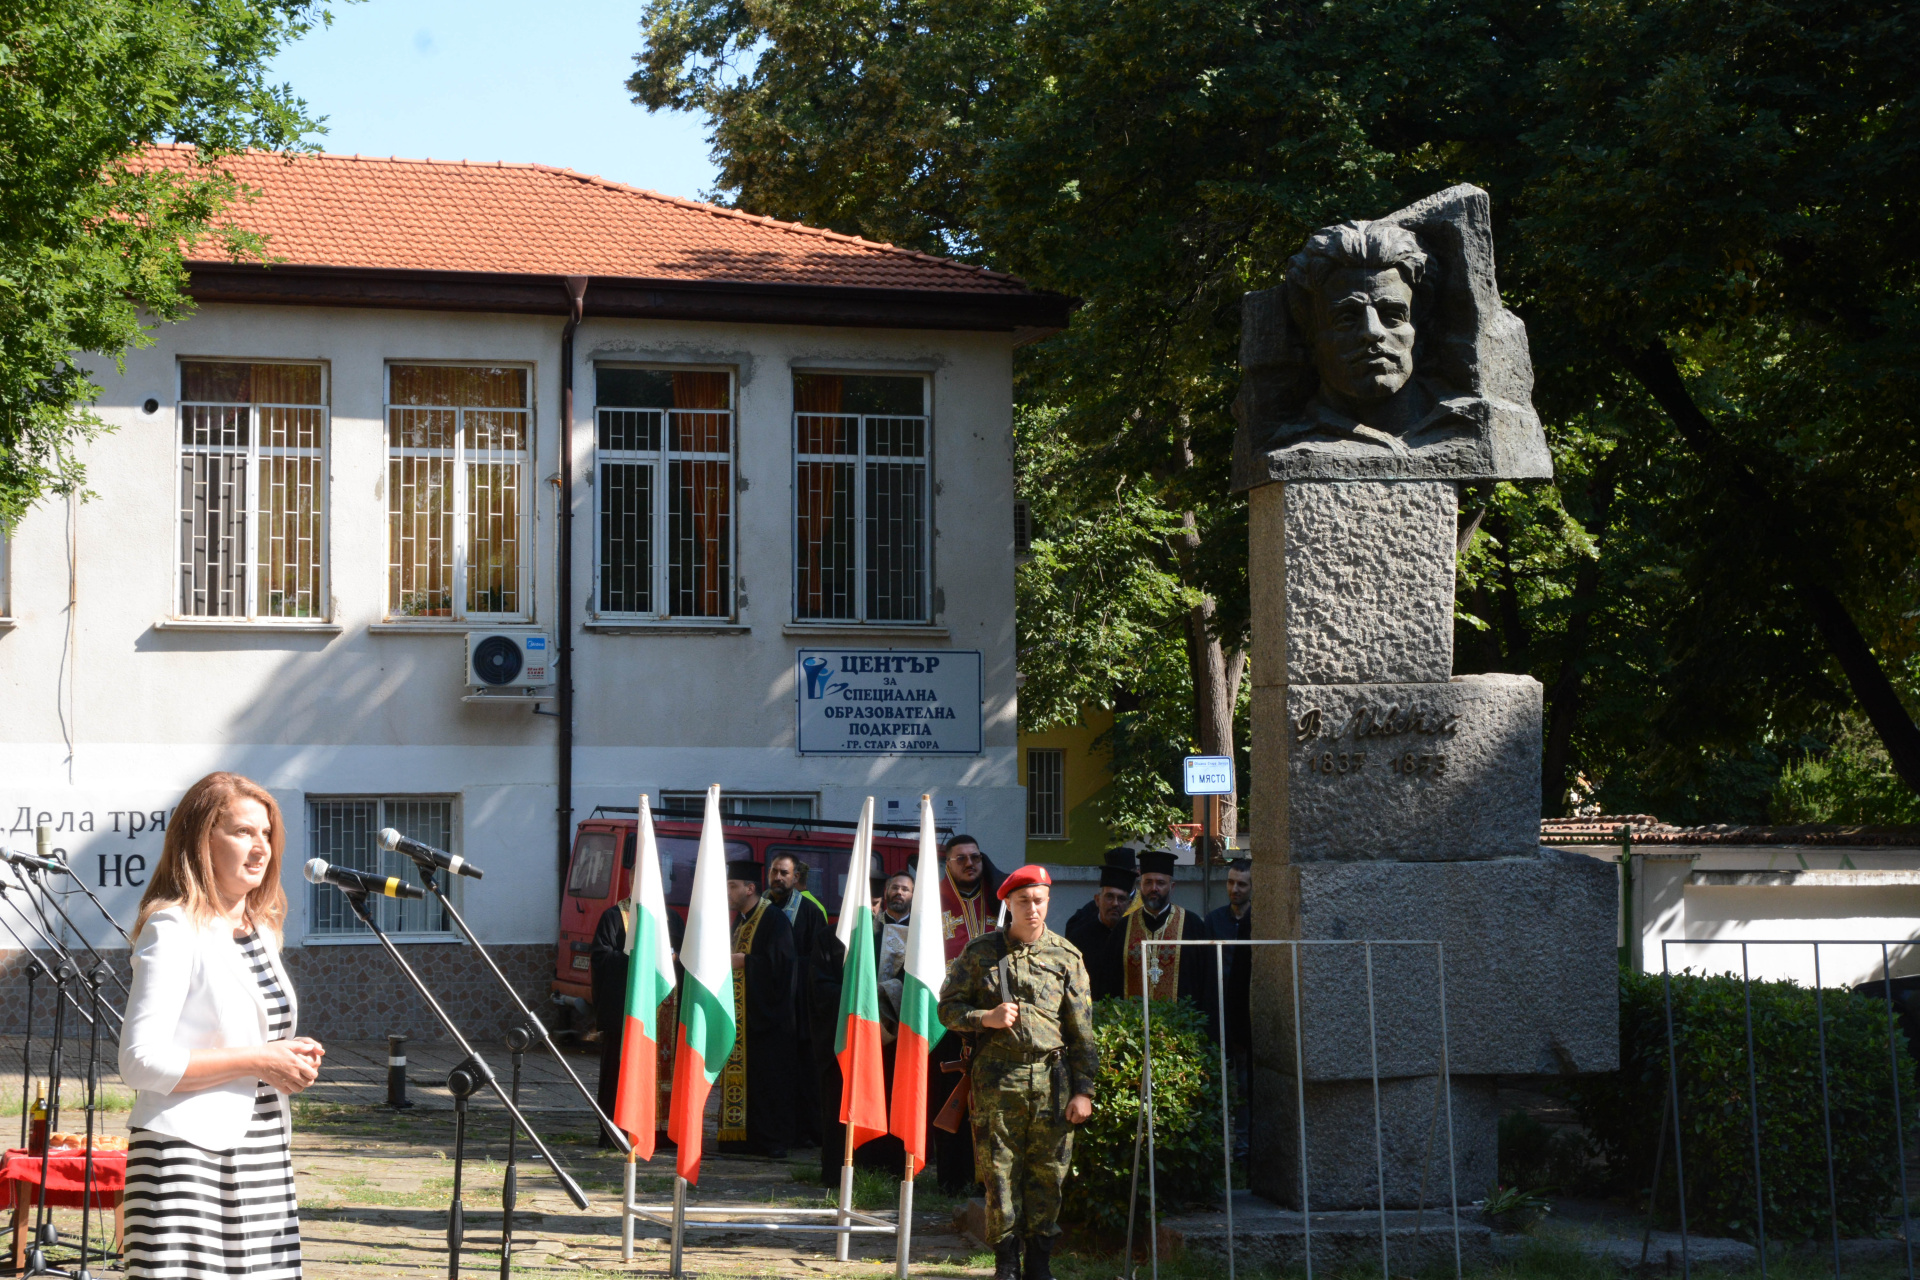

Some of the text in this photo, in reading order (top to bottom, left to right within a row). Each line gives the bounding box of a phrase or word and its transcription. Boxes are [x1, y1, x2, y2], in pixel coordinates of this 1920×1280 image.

[841, 656, 940, 675] ЦЕНТЪР
[883, 677, 897, 686] ЗА
[843, 688, 938, 702] СПЕЦИАЛНА
[824, 706, 956, 719] ОБРАЗОВАТЕЛНА
[849, 723, 932, 736] ПОДКРЕПА
[846, 740, 862, 749] ГР.
[864, 740, 897, 749] СТАРА
[899, 740, 939, 749] ЗАГОРА
[1308, 751, 1366, 774] 1837
[1390, 752, 1448, 774] 1873
[1199, 774, 1226, 783] МЯСТО
[108, 807, 176, 839] тря
[97, 854, 146, 887] не
